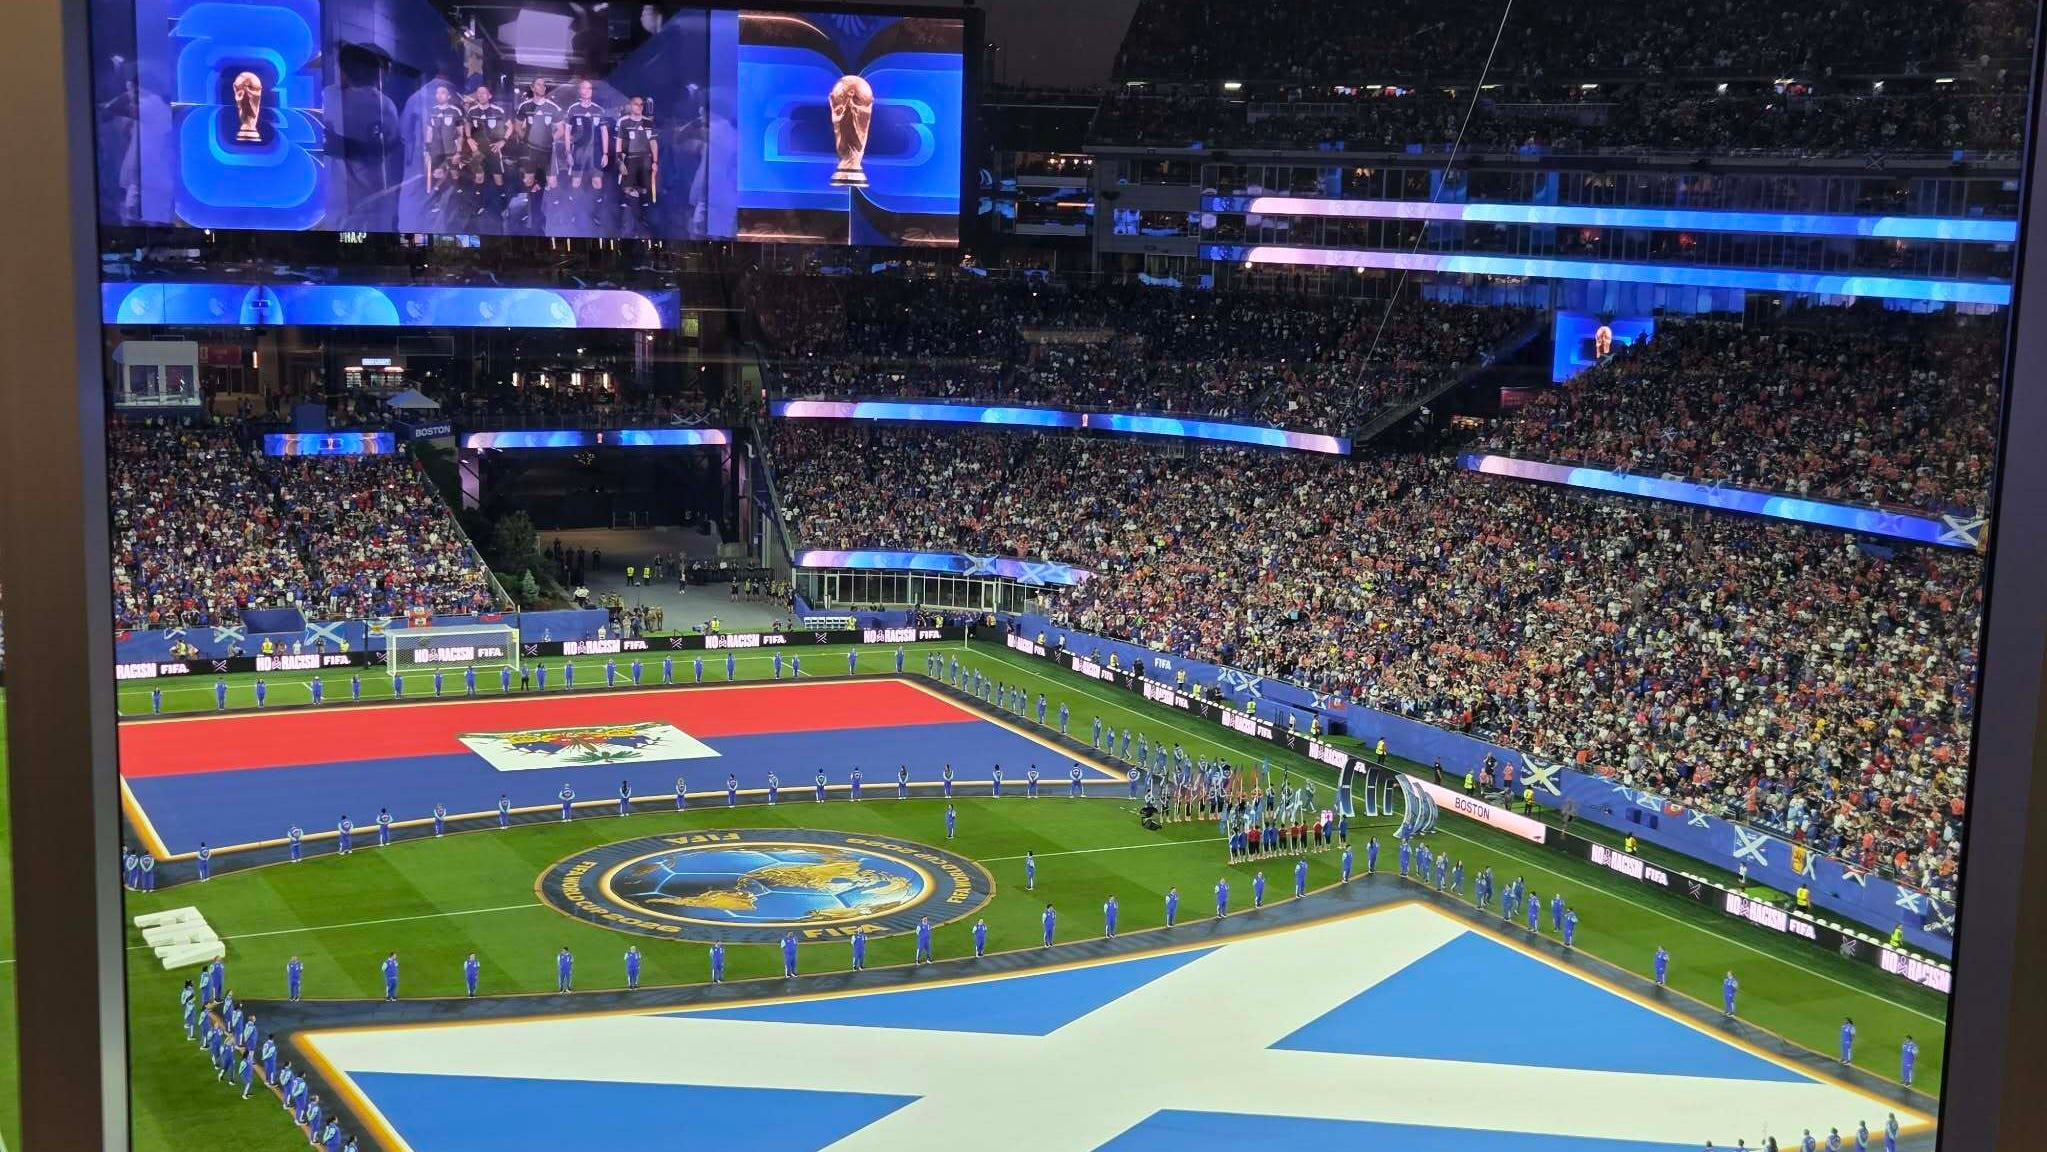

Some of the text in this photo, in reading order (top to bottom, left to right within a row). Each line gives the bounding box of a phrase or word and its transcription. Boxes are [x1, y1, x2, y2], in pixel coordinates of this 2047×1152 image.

[415, 425, 450, 437] BOSTON
[705, 634, 784, 648] NO RACISM FIFA
[863, 628, 939, 643] NO RACISM FIFA
[415, 646, 501, 663] NO RACISM FIFA
[563, 640, 646, 655] NO RACISM FIFA
[256, 654, 348, 671] NO RACISM FIFA
[1155, 657, 1172, 670] FIFA
[115, 662, 186, 679] RACISM FIFA
[1455, 796, 1490, 820] BOSTON
[662, 832, 740, 845] FIFA
[1591, 843, 1668, 886] NO RACISM FIFA
[575, 900, 609, 915] CUP
[1726, 893, 1816, 940] NO RACISM FIFA
[802, 923, 891, 938] FIFA
[1880, 949, 1952, 995] NO RACISM
